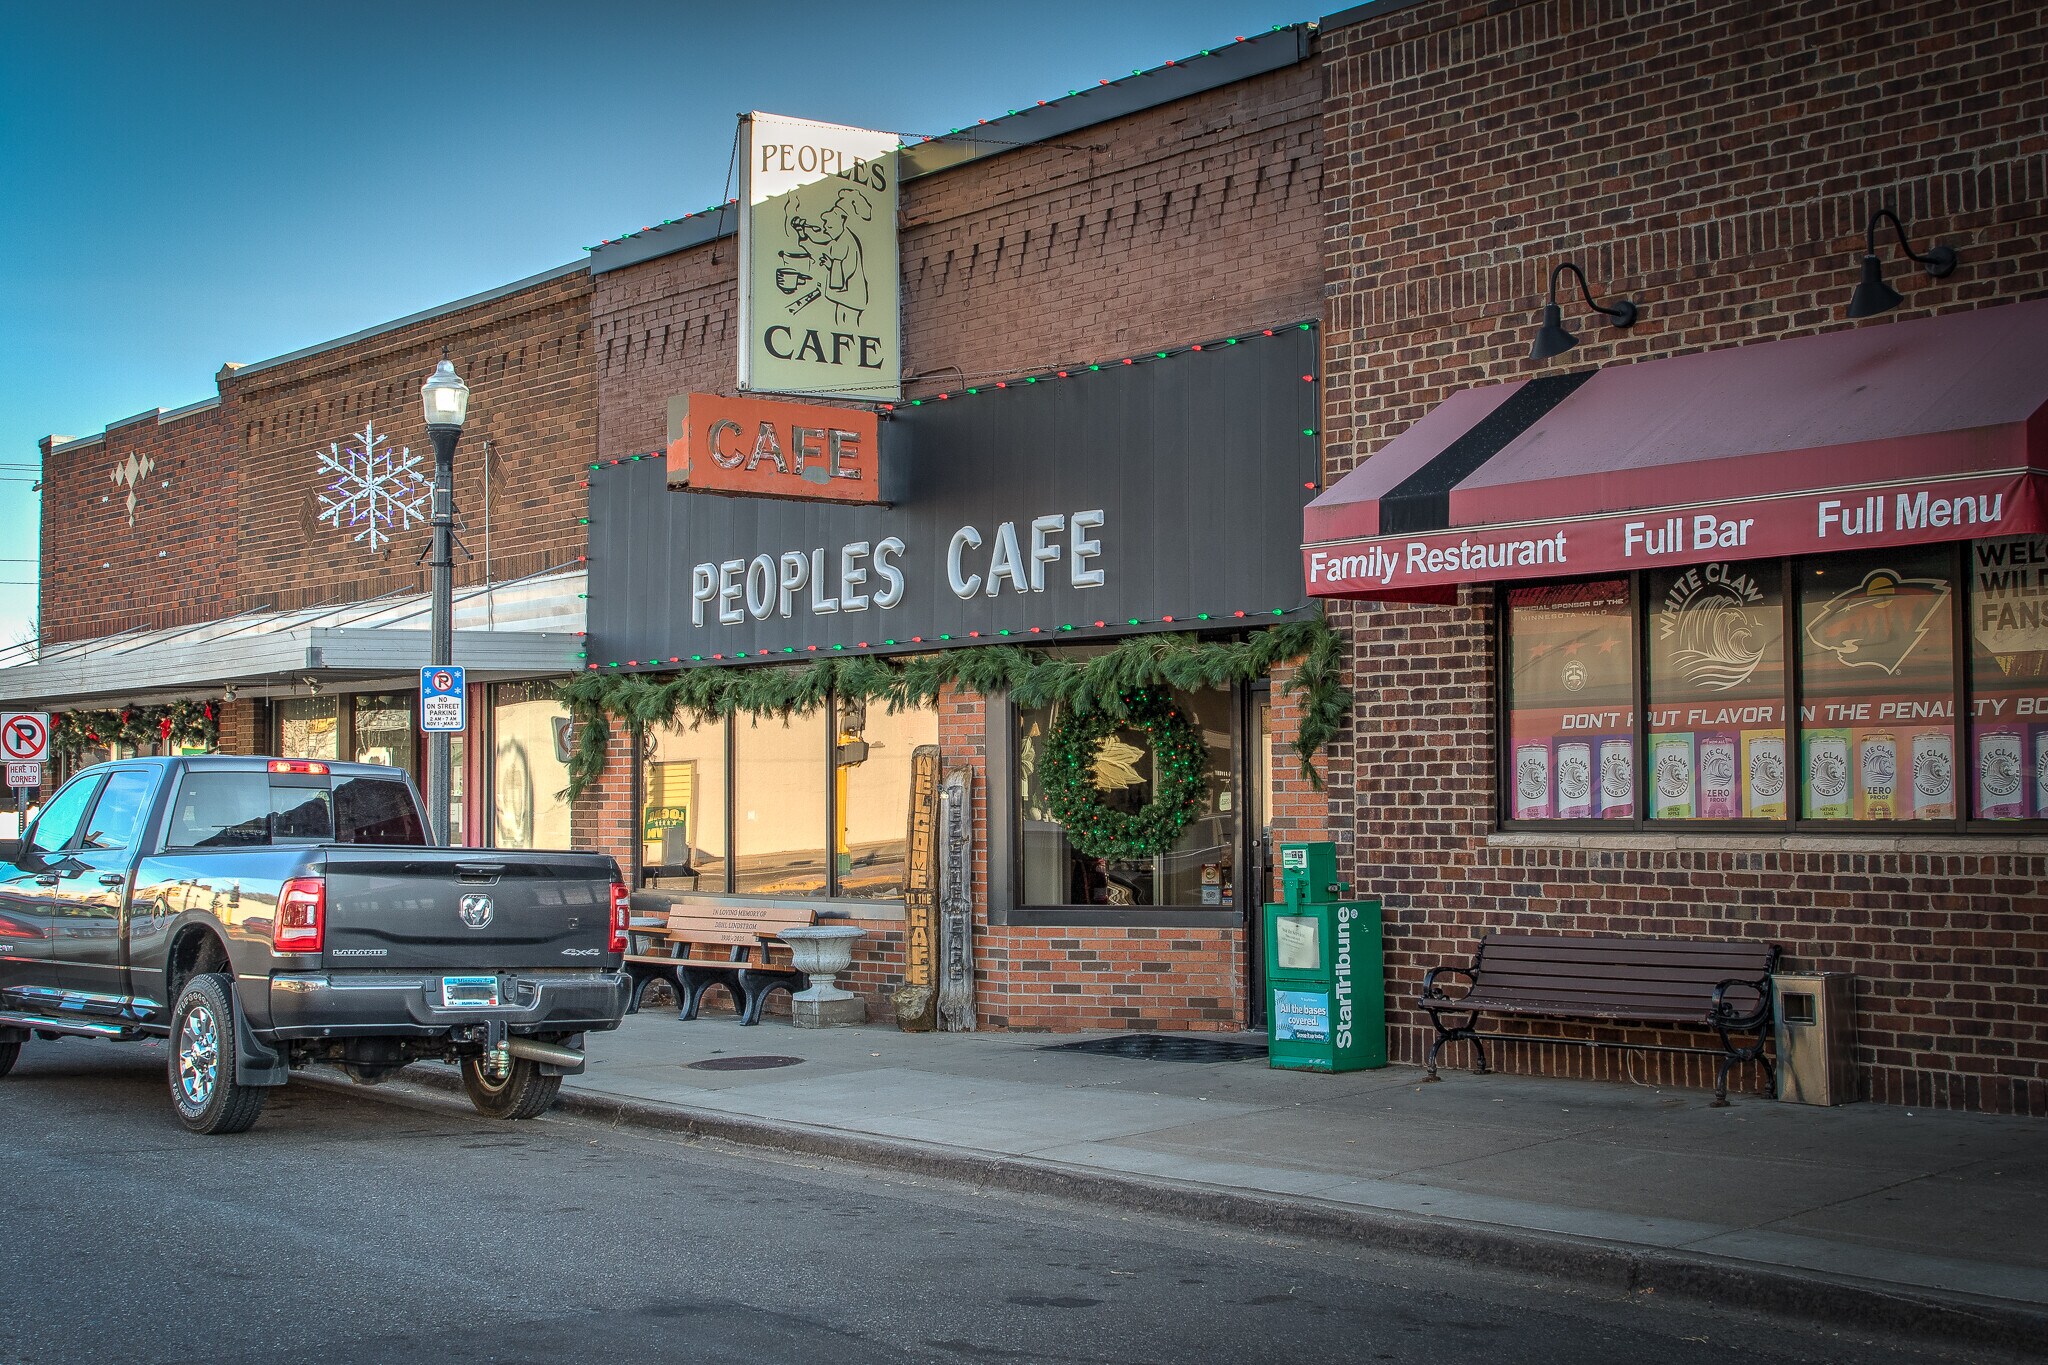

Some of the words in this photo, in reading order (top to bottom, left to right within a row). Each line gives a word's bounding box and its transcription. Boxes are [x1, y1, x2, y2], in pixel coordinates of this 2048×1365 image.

[762, 144, 886, 192] PEOPLES
[764, 325, 884, 370] CAFE
[706, 418, 862, 480] CAFE
[1818, 496, 1884, 538] Full
[1896, 492, 2002, 530] Menu
[1624, 518, 1682, 556] Full
[1693, 514, 1754, 550] Bar
[692, 536, 906, 628] PEOPLES
[946, 509, 1105, 600] CAFE
[1310, 546, 1399, 584] Family
[1406, 530, 1567, 574] Restaurant
[1977, 542, 2048, 567] WEL
[1552, 601, 1590, 610] SPONSOR
[1660, 568, 1702, 640] WHITE
[1705, 563, 1764, 602] CLAW
[1520, 612, 1577, 622] MINNESOTA
[1562, 712, 1620, 730] DON'T
[1687, 706, 1773, 724] FLAVOR
[1824, 704, 1872, 720] THE
[1880, 698, 2008, 720] PENALTY
[2016, 698, 2048, 715] BO
[1518, 762, 1530, 784] WHITE
[1528, 758, 1546, 772] CLAW
[1560, 760, 1570, 784] WHITE
[1570, 758, 1588, 770] CLAW
[1602, 757, 1611, 782] WHITE
[1612, 754, 1631, 768] CLAW
[1657, 758, 1667, 782] WHITE
[1668, 755, 1687, 768] CLAW
[1703, 750, 1714, 771] WHITE
[1716, 748, 1732, 761] CLAW
[1750, 755, 1761, 781] WHITE
[1762, 752, 1783, 766] CLAW
[1811, 754, 1822, 780] WHITE
[1823, 752, 1845, 766] CLAW
[1863, 747, 1875, 768] WHITE
[1876, 745, 1894, 758] CLAW
[1914, 753, 1925, 779] WHITE
[1926, 750, 1949, 764] CLAW
[1981, 752, 1994, 779] WHITE
[1995, 749, 2019, 763] CLAW
[910, 756, 932, 889] WELCOME
[905, 893, 915, 904] TO
[918, 893, 932, 904] THE
[911, 908, 928, 984] CAFE
[1335, 906, 1352, 1049] StarTribune
[1281, 1004, 1290, 1013] All
[1292, 1004, 1303, 1014] the
[1304, 1005, 1326, 1016] bases
[1289, 1016, 1319, 1026] covered.
